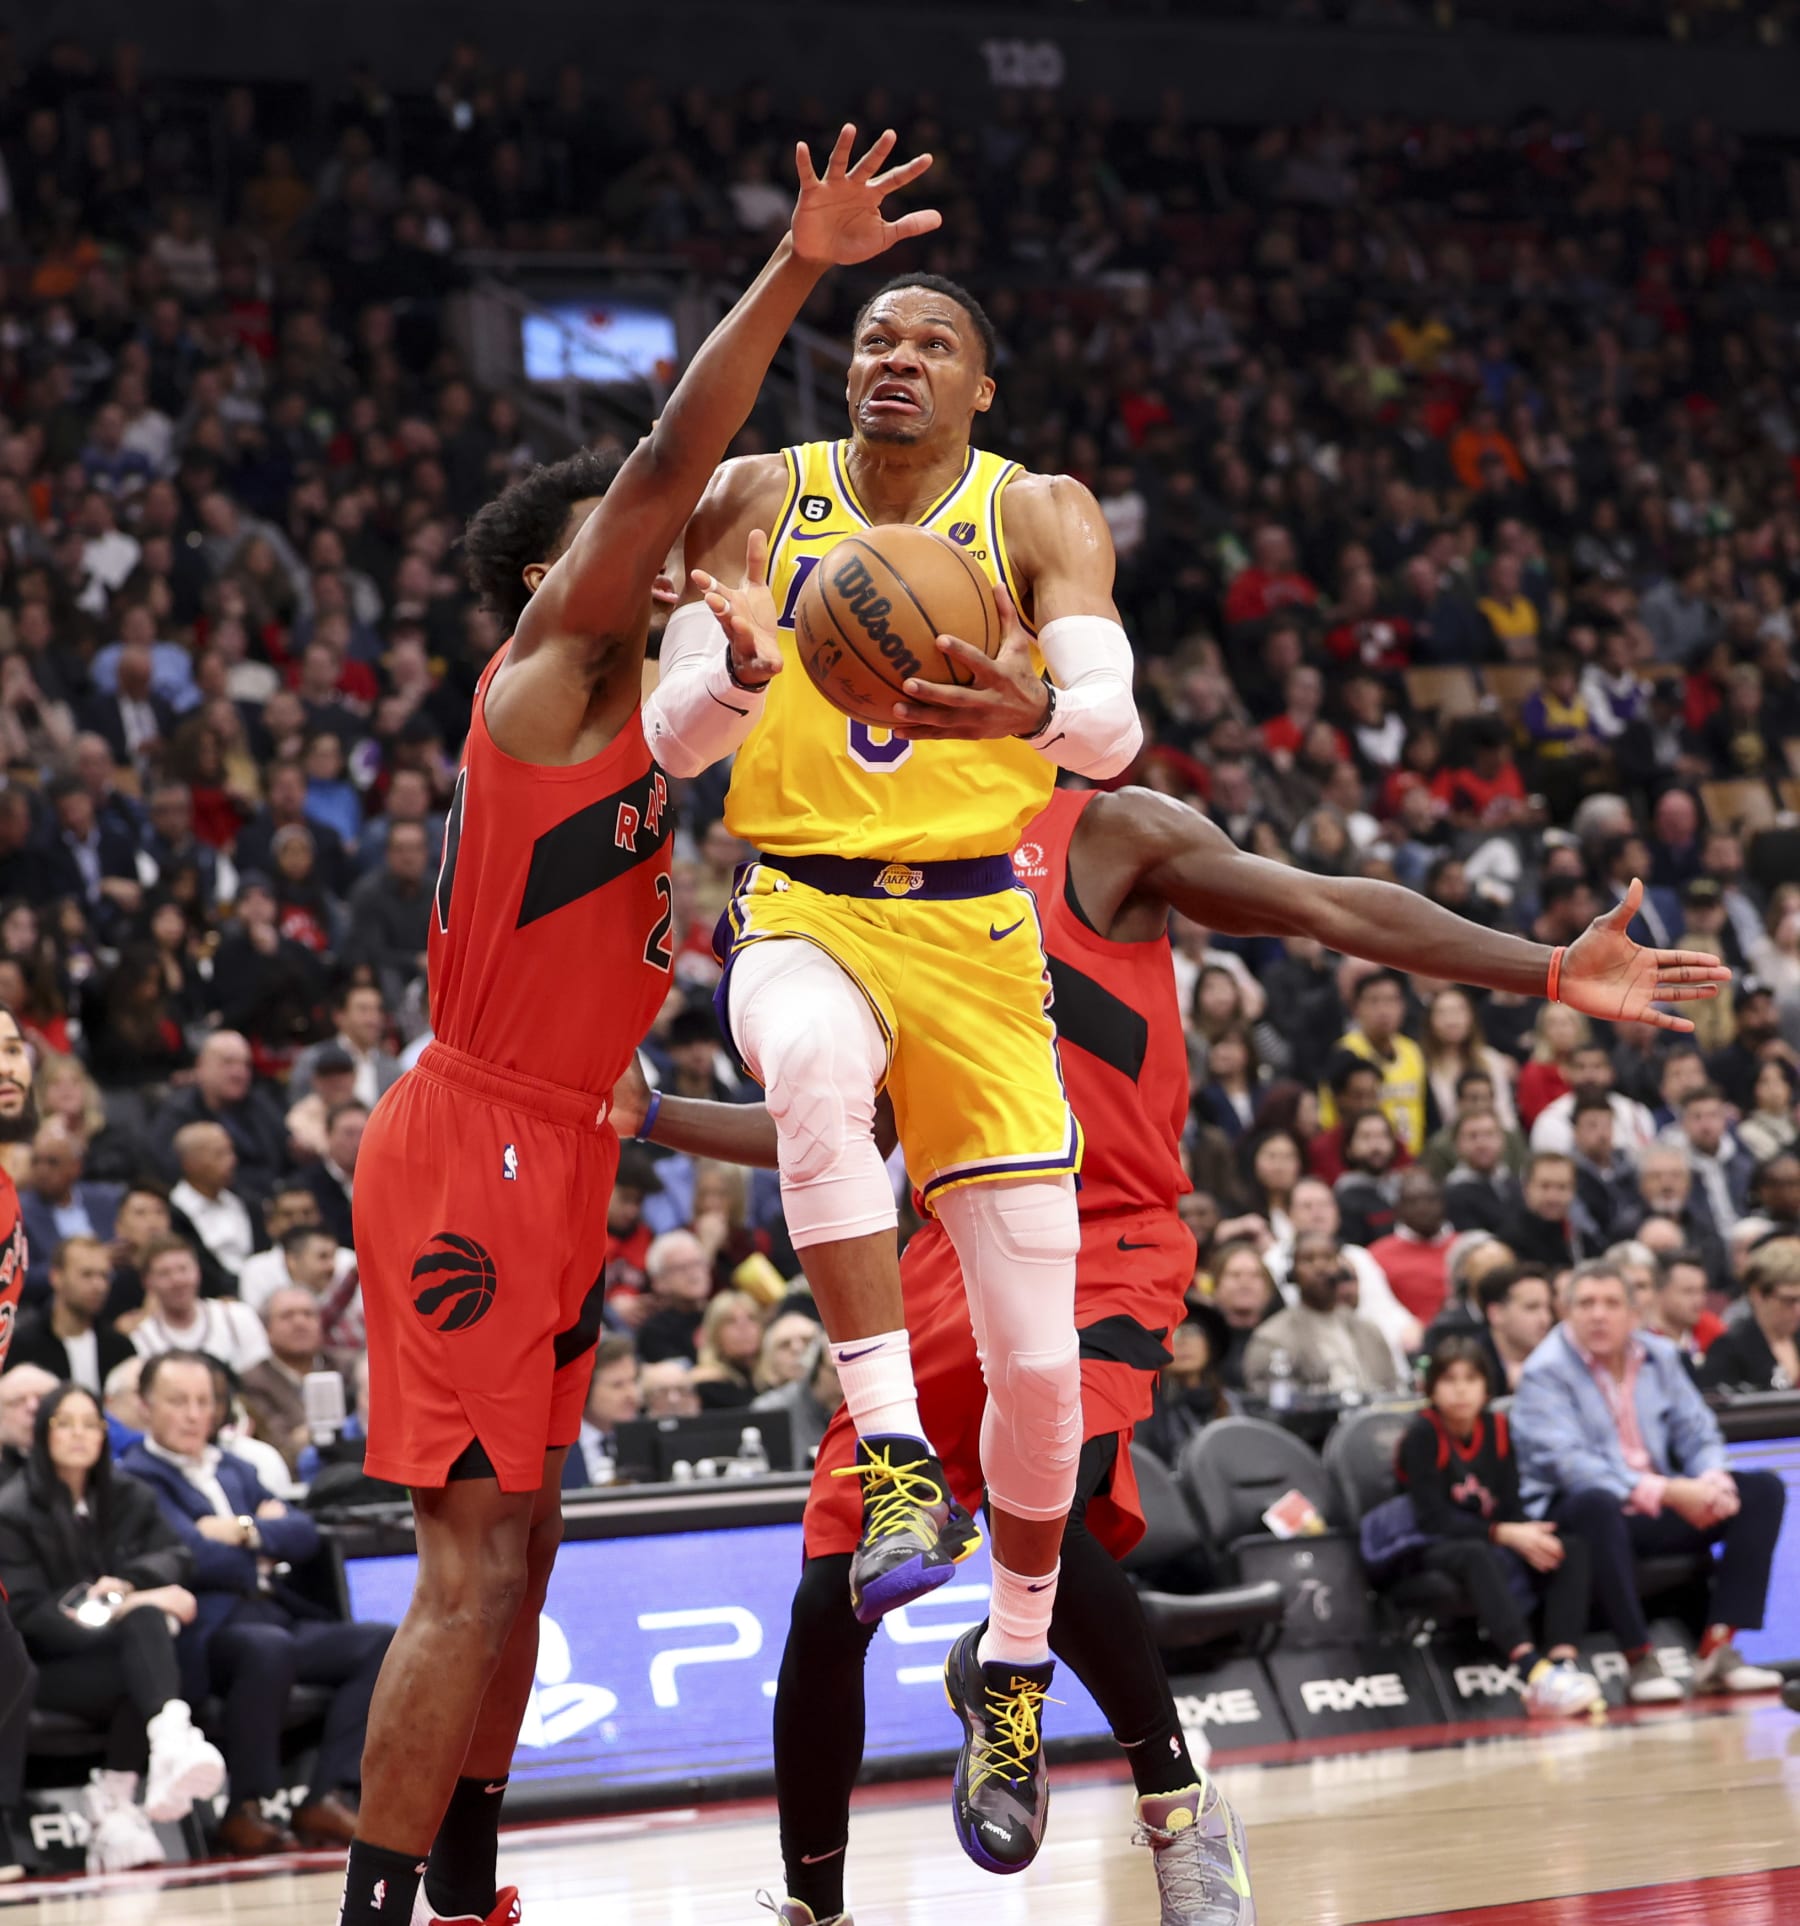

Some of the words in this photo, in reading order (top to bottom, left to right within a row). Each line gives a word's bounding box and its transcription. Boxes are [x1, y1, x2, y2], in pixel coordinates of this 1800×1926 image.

[805, 500, 825, 519] 6
[834, 554, 921, 680] Wilson
[873, 870, 925, 890] LAKERS
[1301, 1673, 1409, 1714] AXE
